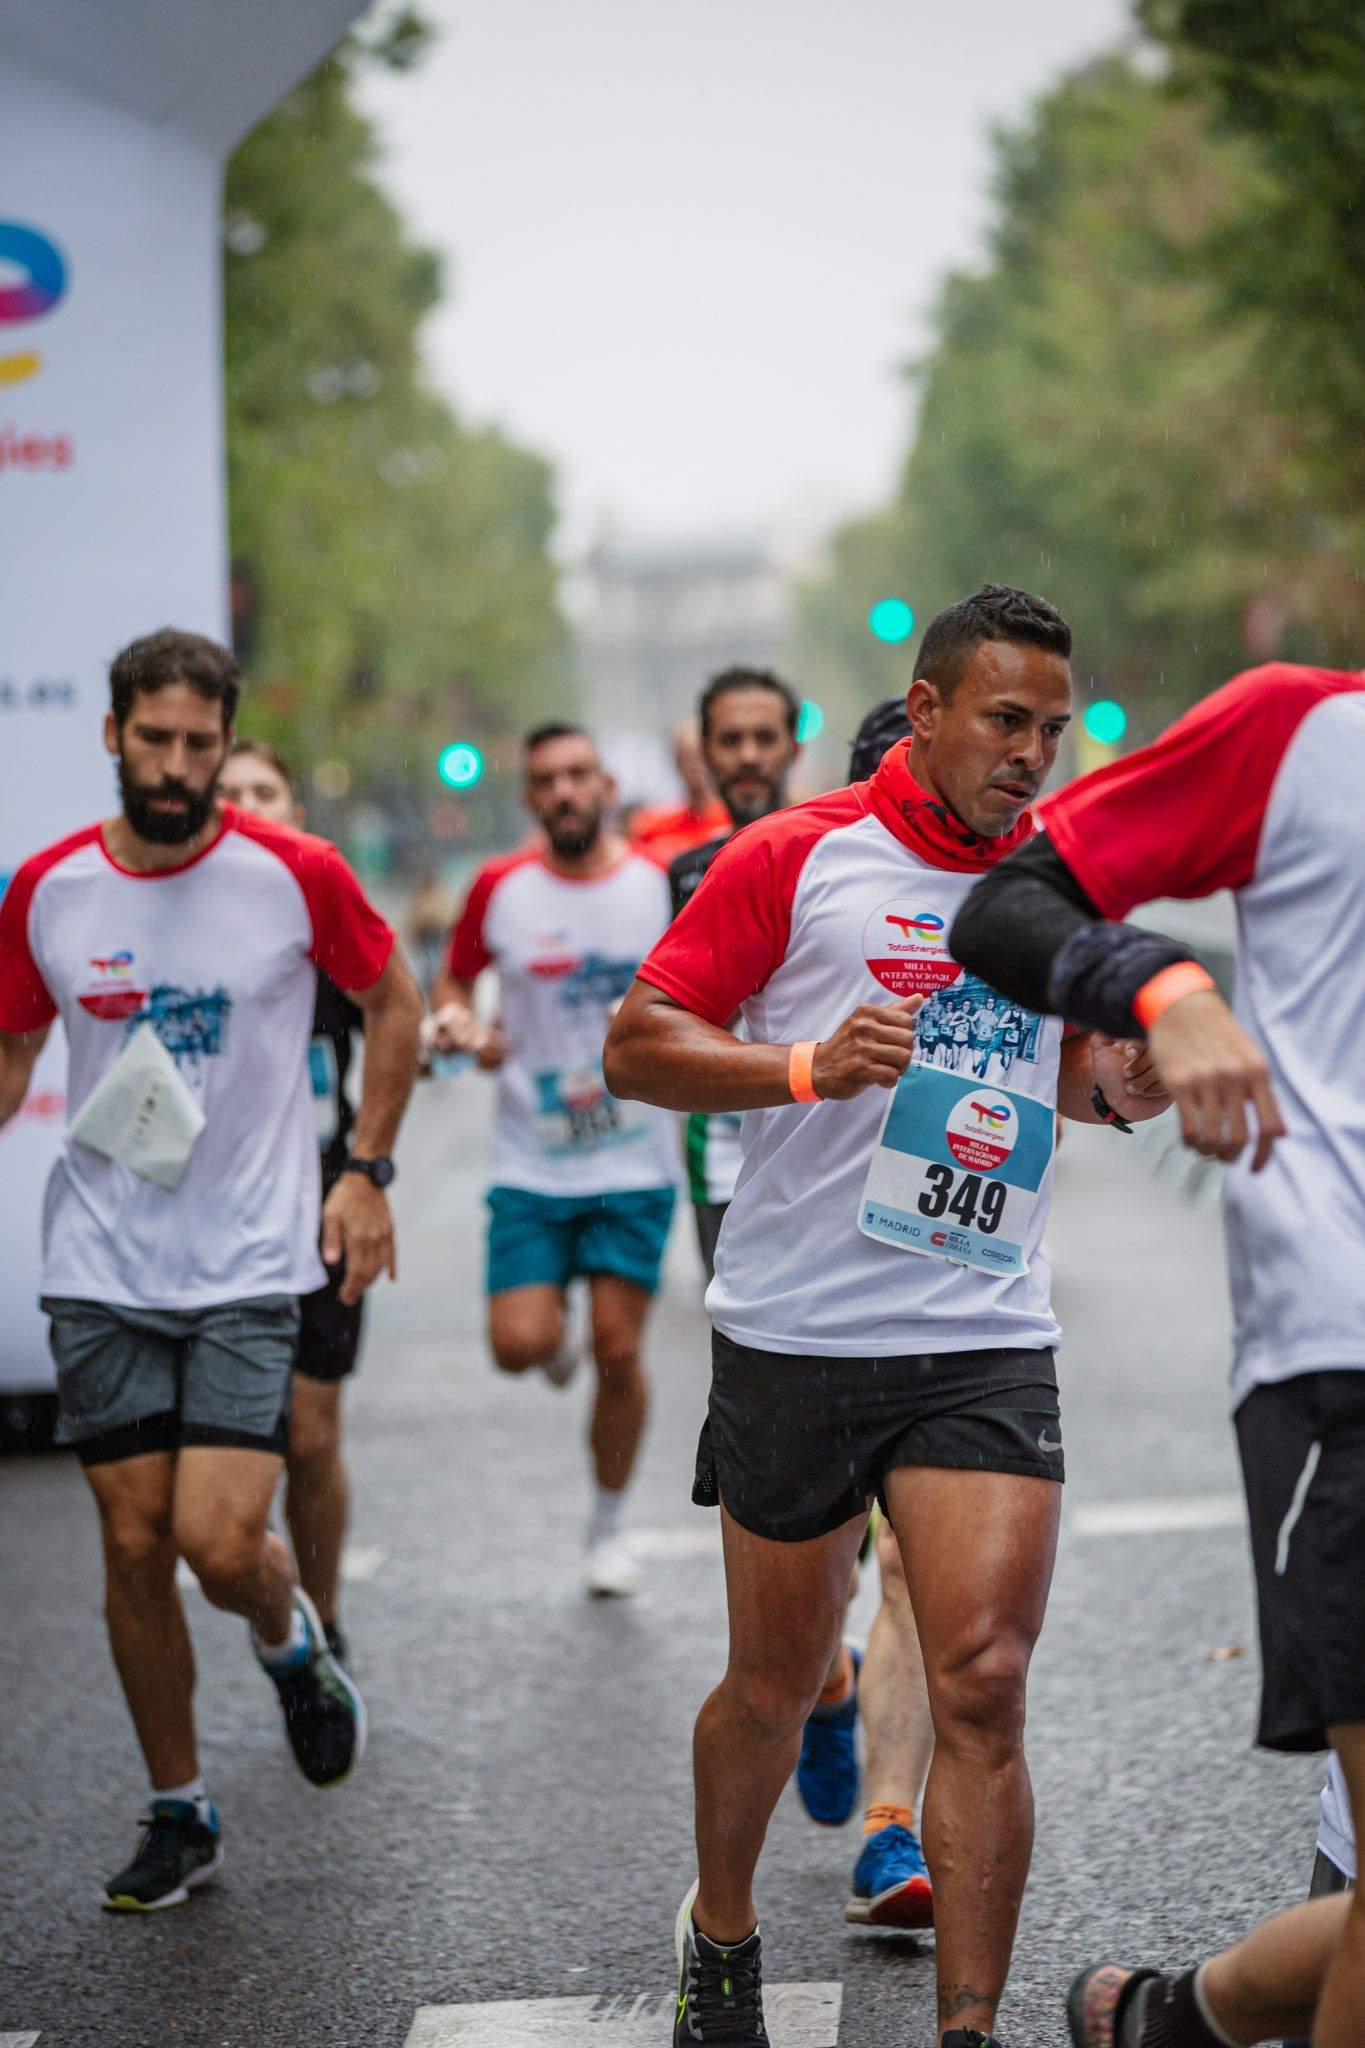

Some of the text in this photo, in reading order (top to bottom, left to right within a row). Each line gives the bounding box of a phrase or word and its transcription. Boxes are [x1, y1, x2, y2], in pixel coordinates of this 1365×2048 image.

[0, 419, 72, 472] ies
[904, 962, 933, 972] MILLA
[880, 971, 952, 982] INTERNACIONAL
[891, 981, 905, 989] DE
[964, 1123, 1005, 1142] TotalEnergies
[970, 1140, 990, 1152] MILLA
[967, 1155, 994, 1168] MADRID
[917, 1163, 1007, 1234] 349
[878, 1217, 921, 1237] MADRID
